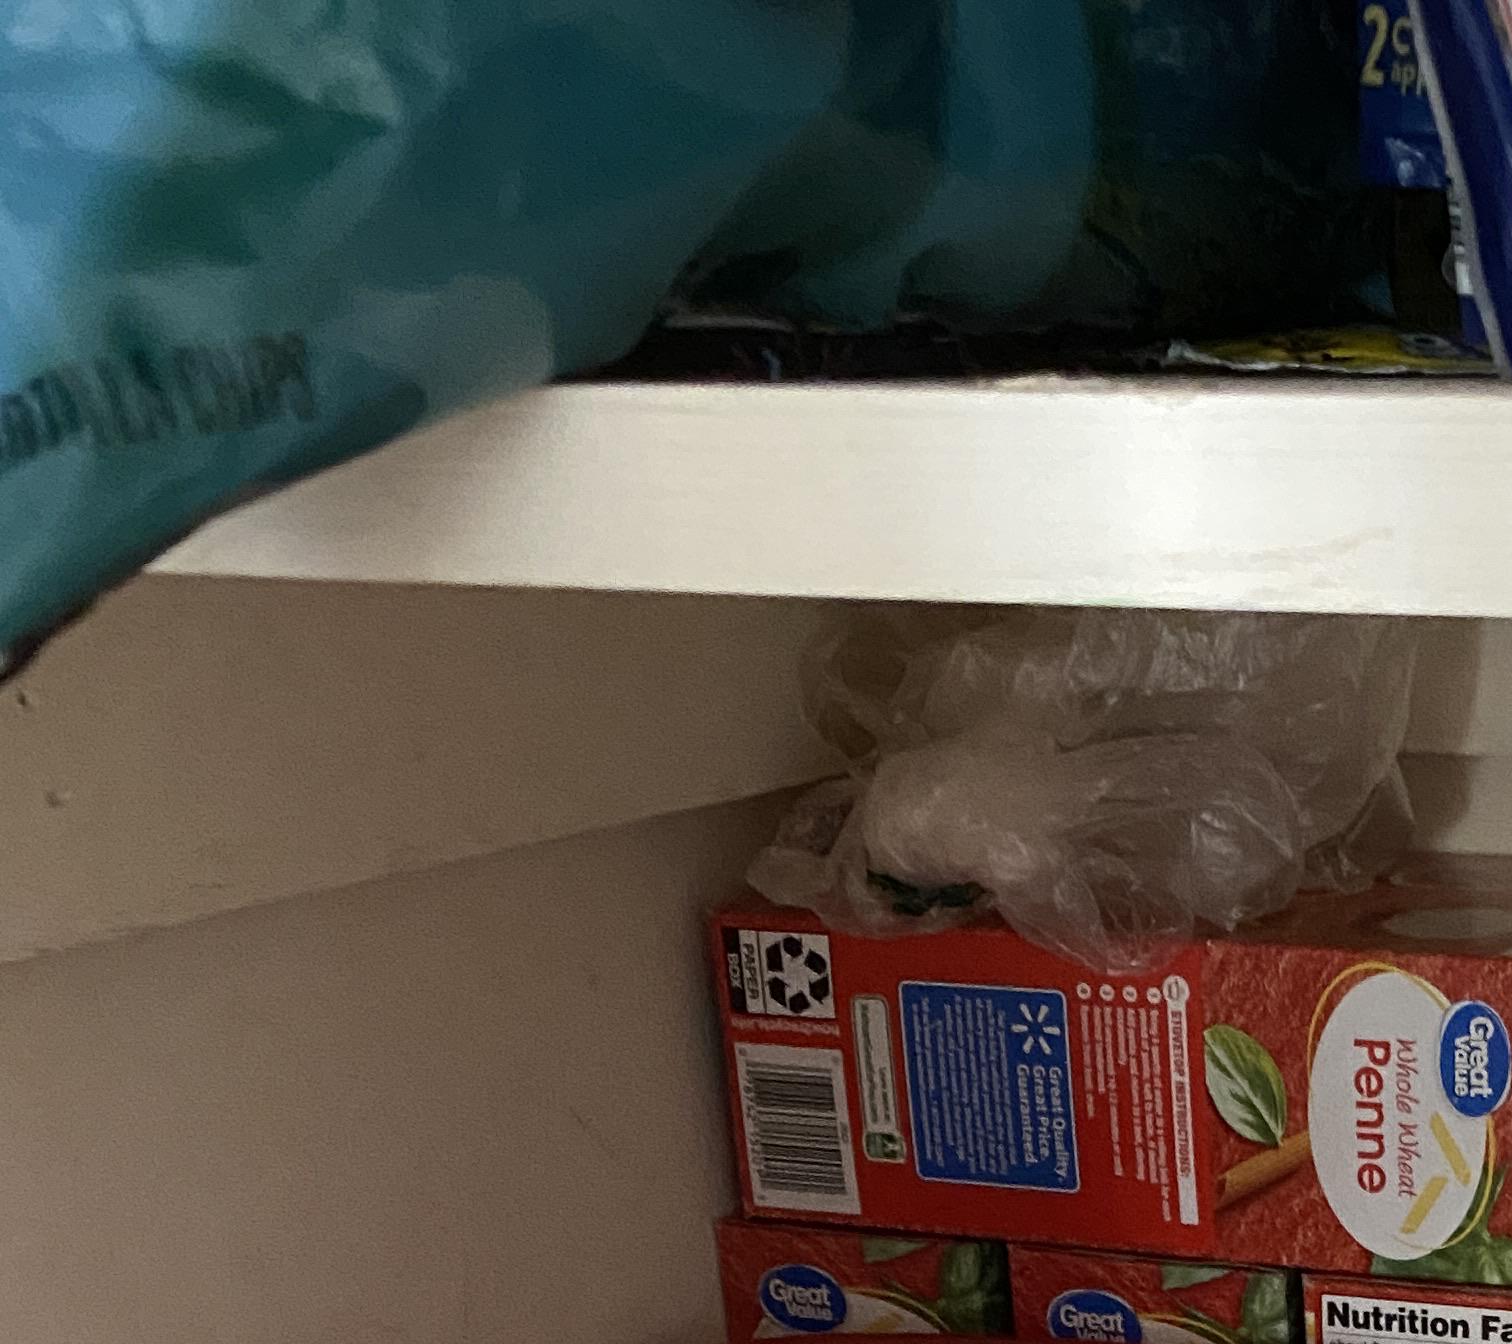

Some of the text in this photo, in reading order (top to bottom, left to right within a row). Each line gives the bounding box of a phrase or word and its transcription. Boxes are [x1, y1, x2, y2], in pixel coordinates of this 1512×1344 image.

[741, 943, 760, 1001] PAPER
[1453, 1034, 1472, 1097] Value
[1468, 1016, 1495, 1099] Great
[1033, 1065, 1047, 1113] Great
[1049, 1066, 1064, 1113] Great
[1353, 1037, 1391, 1194] Penne
[1396, 1037, 1424, 1199] Whole Wheat
[769, 1278, 831, 1305] Great
[785, 1299, 833, 1321] Value
[1060, 1304, 1124, 1334] Great
[1327, 1300, 1470, 1339] Nutrition
